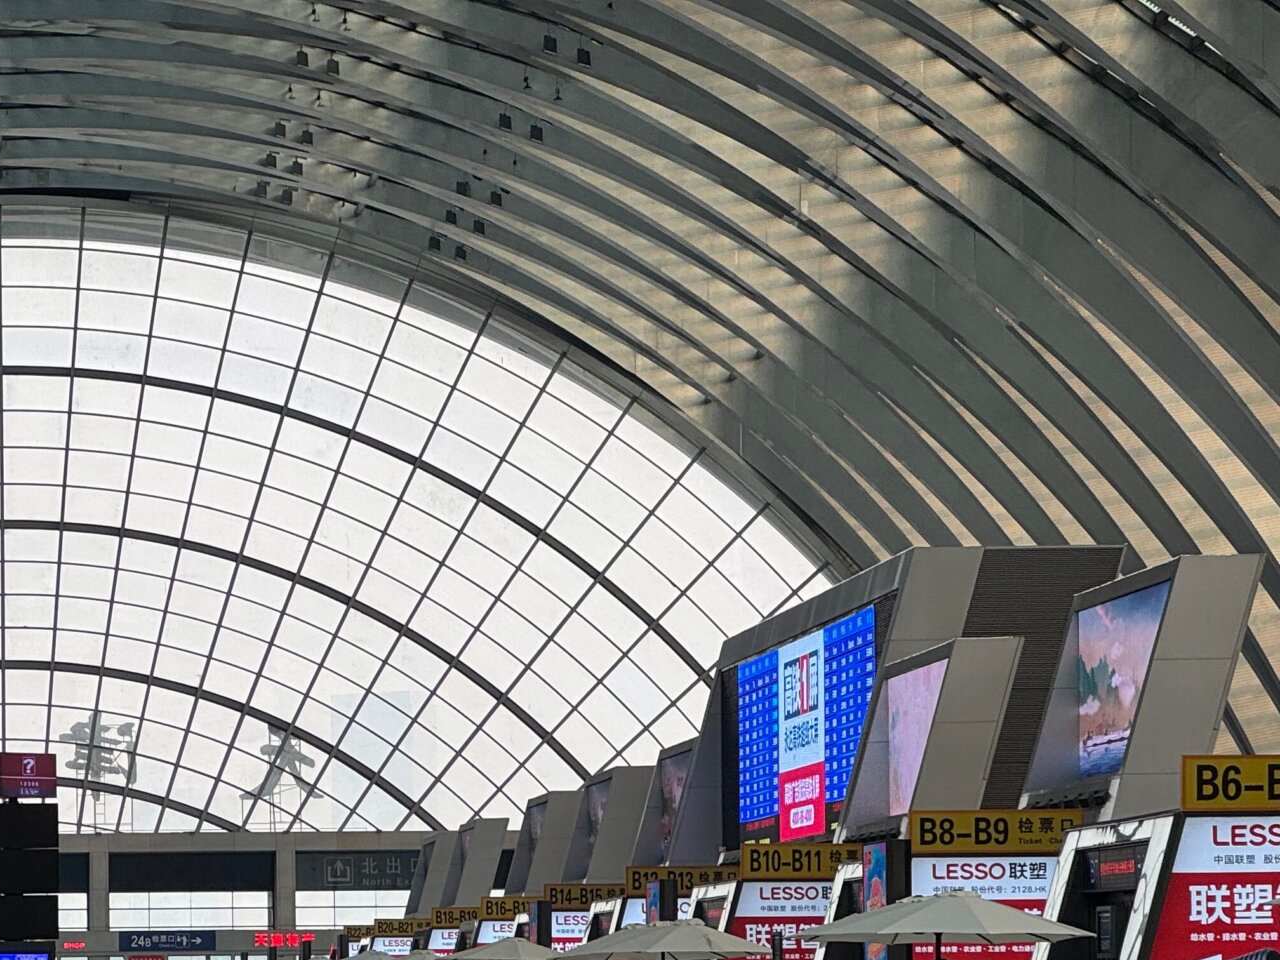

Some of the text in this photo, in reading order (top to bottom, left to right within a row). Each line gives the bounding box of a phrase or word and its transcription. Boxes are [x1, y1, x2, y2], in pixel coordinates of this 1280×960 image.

[920, 817, 1009, 845] B8-B9
[1018, 837, 1042, 845] Ticket
[750, 849, 821, 873] B10-B11
[1214, 854, 1255, 865] 中国联塑
[933, 862, 1048, 880] LESSO 联塑
[362, 878, 392, 886] North
[759, 886, 819, 901] LESSO
[486, 900, 530, 915] B16-B1
[1189, 884, 1280, 925] 联塑
[63, 941, 86, 949] SHOP
[131, 935, 152, 948] 24B
